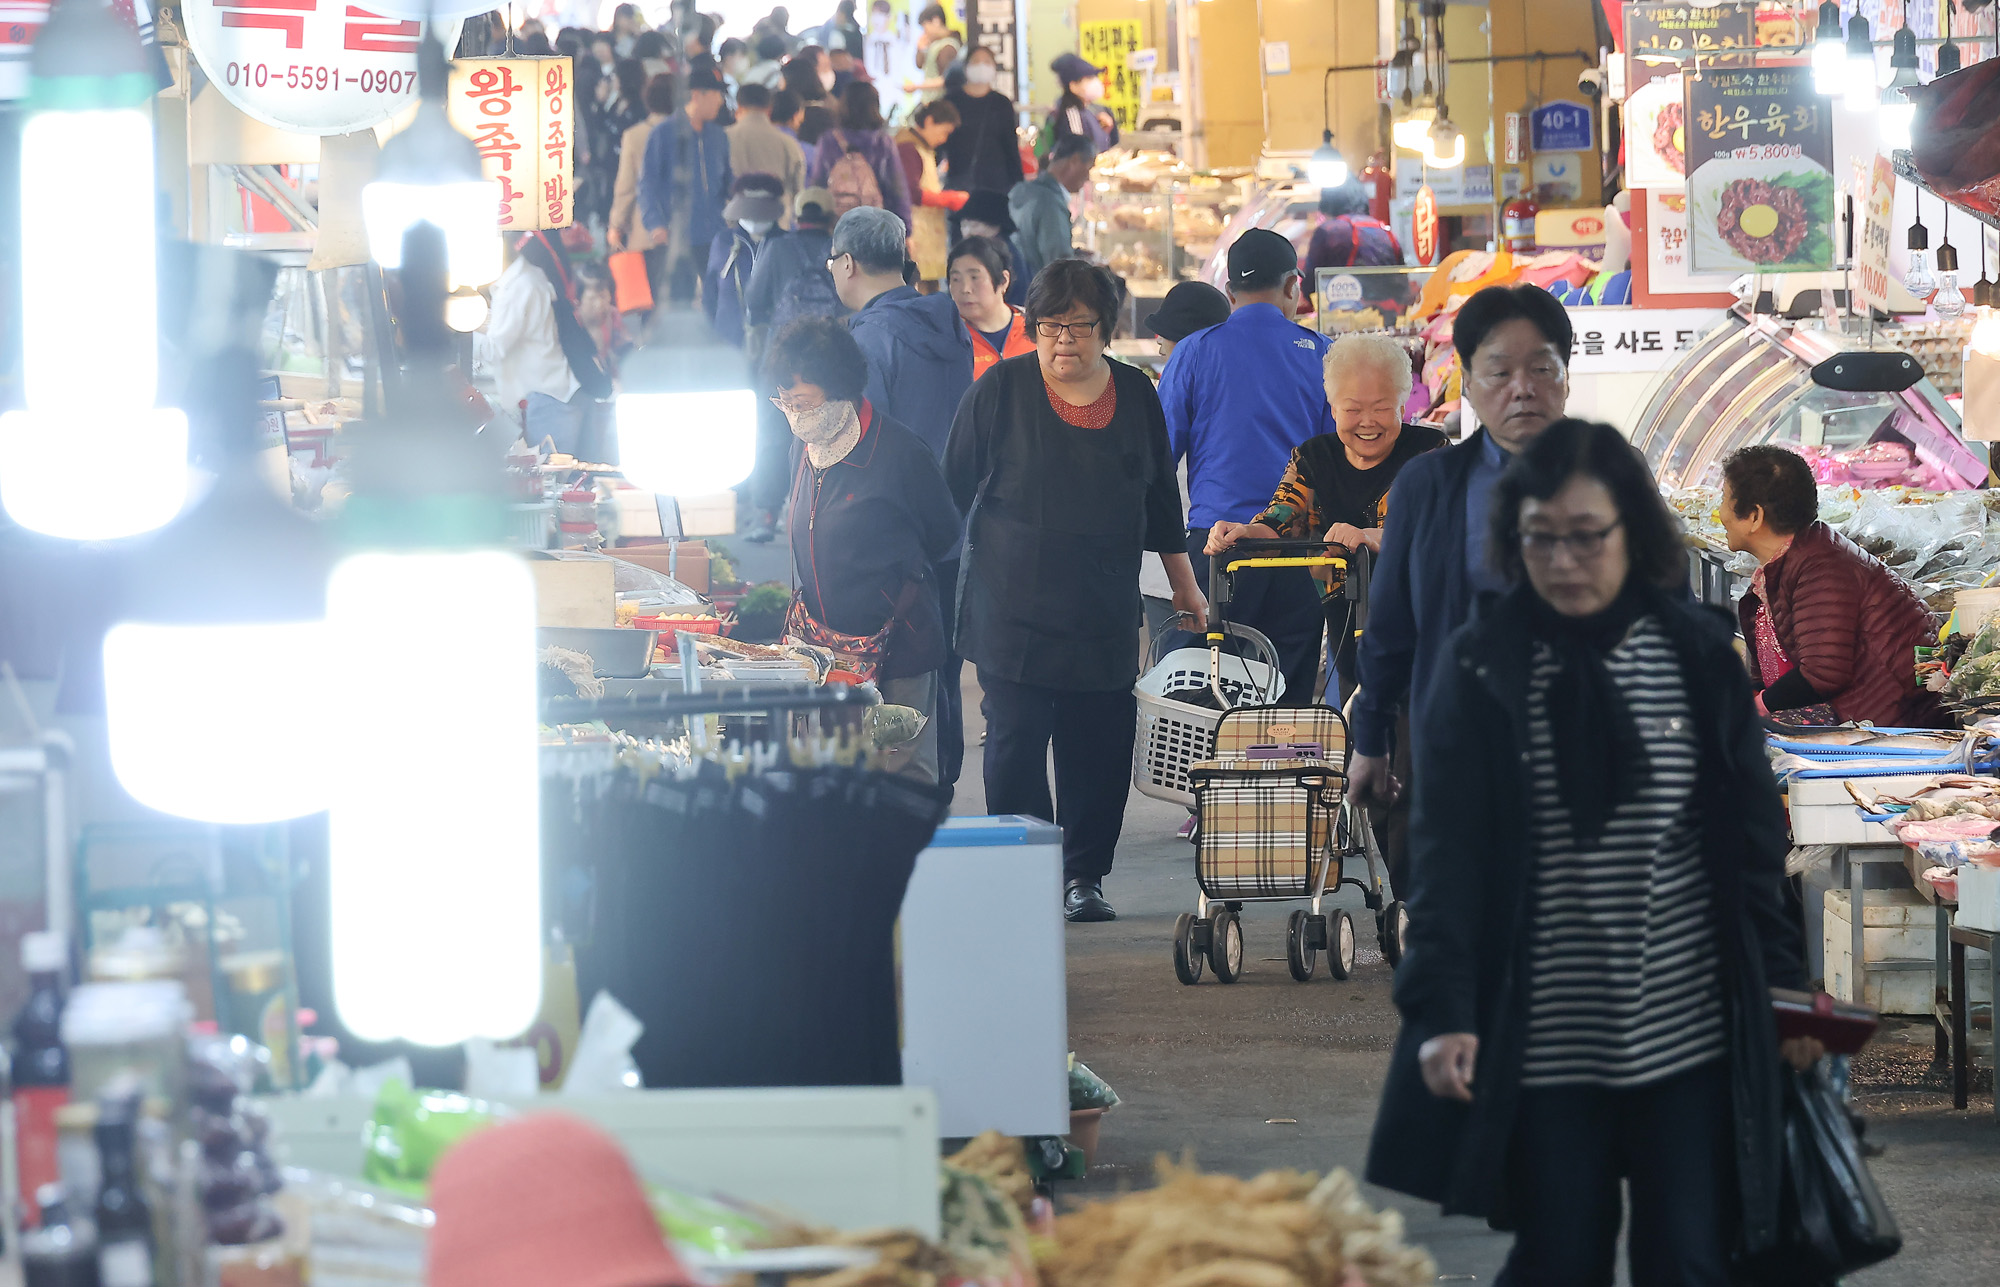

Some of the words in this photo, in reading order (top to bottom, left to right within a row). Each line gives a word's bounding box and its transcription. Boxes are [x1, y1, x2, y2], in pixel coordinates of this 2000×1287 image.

[226, 61, 417, 95] 010-5591-0907
[1541, 109, 1580, 129] 40-1
[1696, 102, 1819, 140] 한우육회
[543, 64, 568, 223] 왕족발
[1615, 330, 1663, 353] 사도
